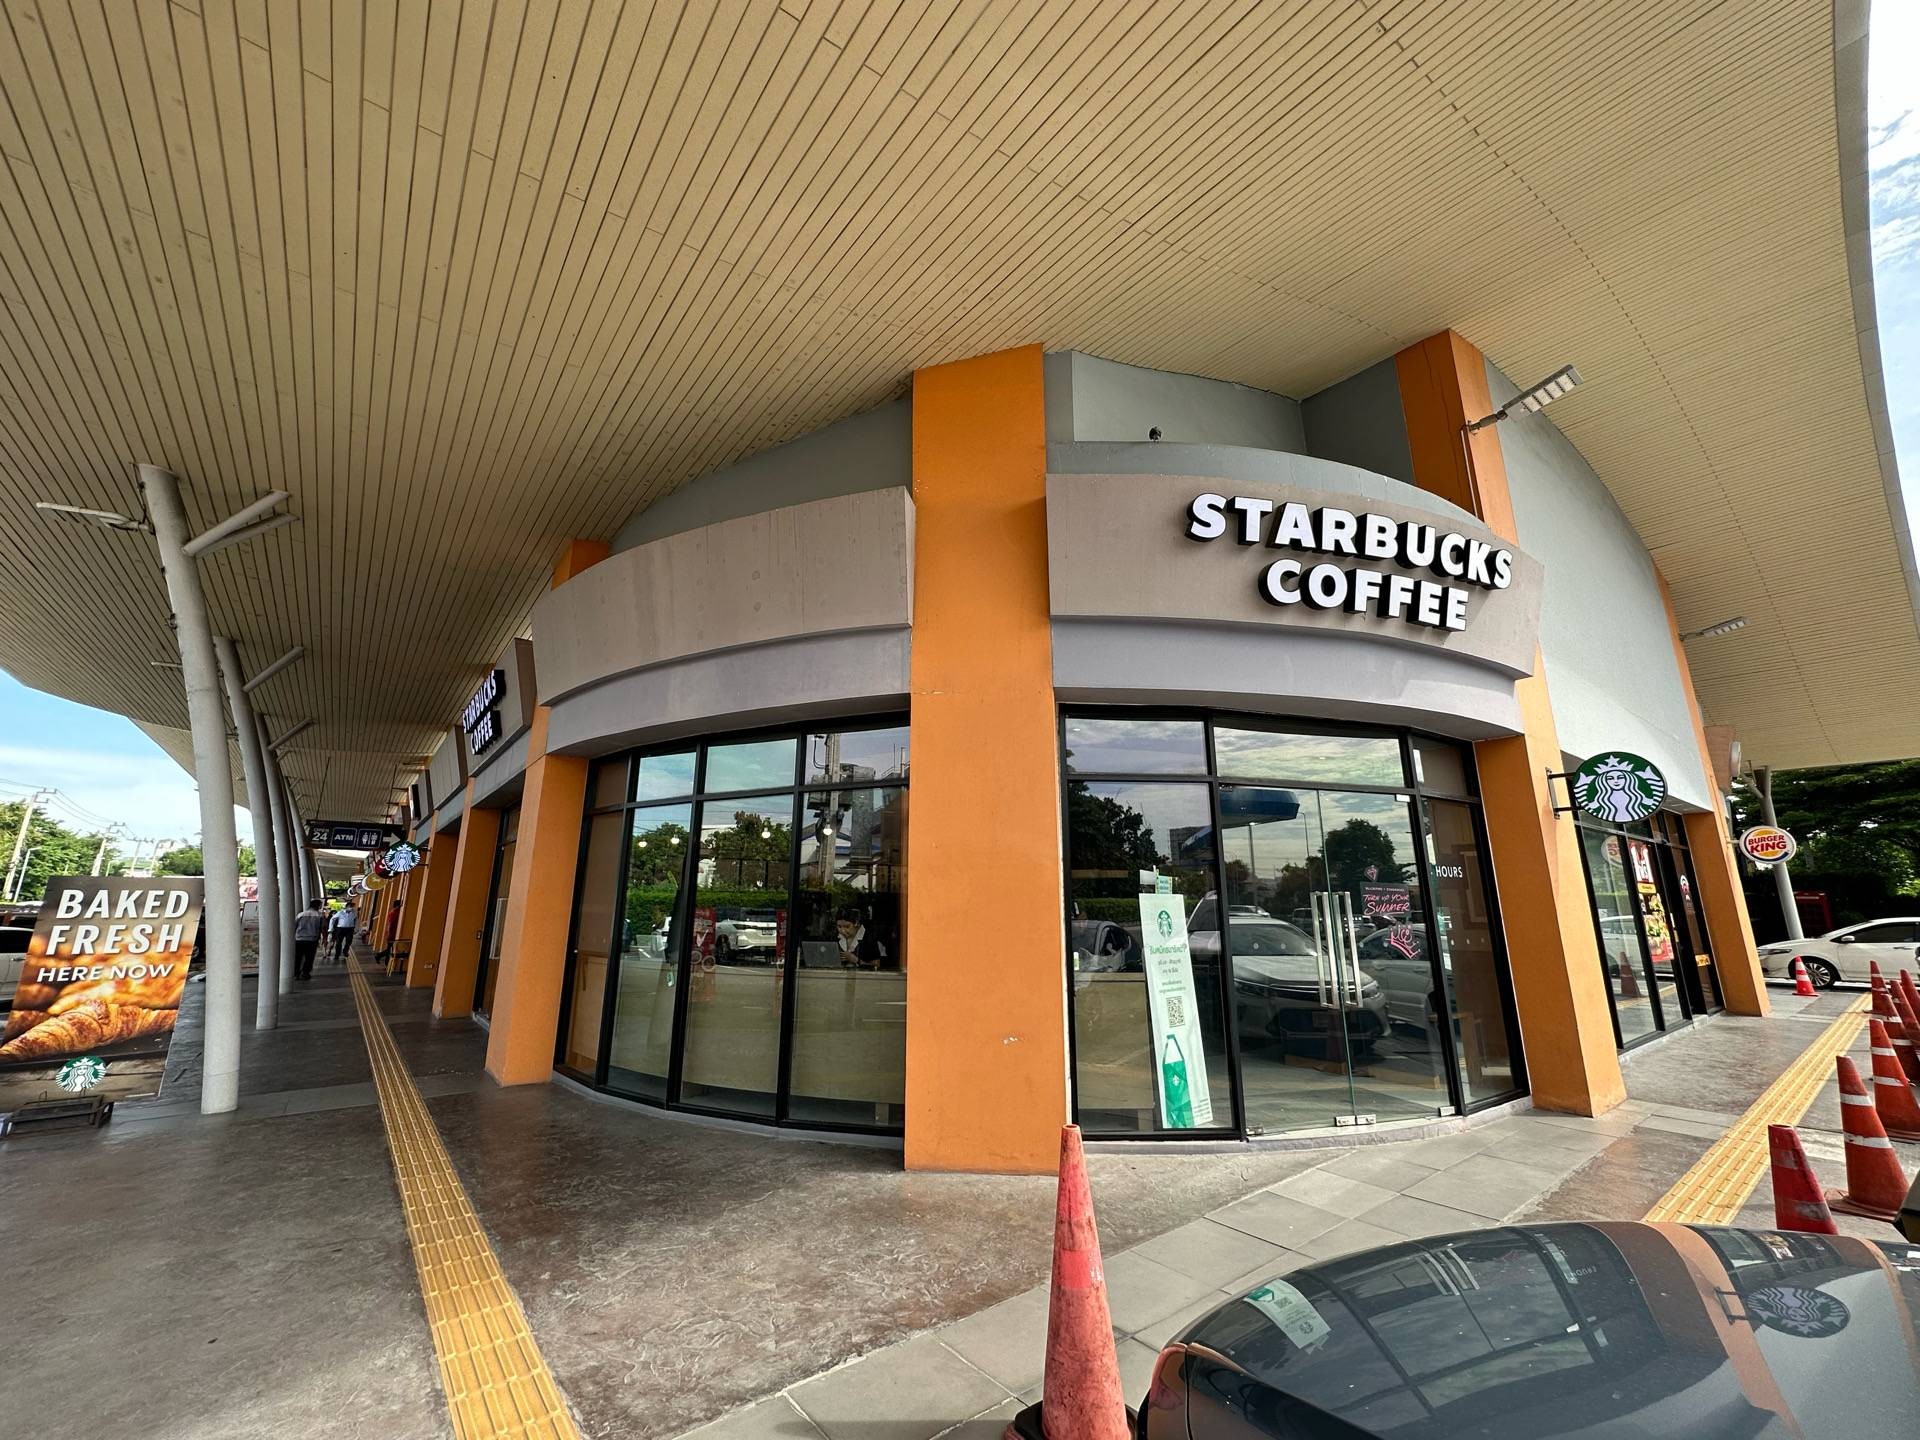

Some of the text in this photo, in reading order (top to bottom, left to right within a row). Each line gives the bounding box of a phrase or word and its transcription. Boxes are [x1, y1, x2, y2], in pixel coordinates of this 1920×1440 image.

[1187, 493, 1513, 589] STARBUCKS
[1260, 558, 1470, 631] COFFEE
[463, 670, 497, 733] STARBUCKS
[470, 711, 493, 755] COFFEE
[312, 832, 328, 841] 24
[1748, 835, 1785, 845] BURGER
[1750, 841, 1786, 853] KING
[1435, 865, 1463, 878] HOURS
[56, 889, 189, 919] BAKED
[1364, 902, 1410, 916] SUMMER
[46, 924, 183, 955] FRESH
[37, 963, 174, 983] HERE NOW
